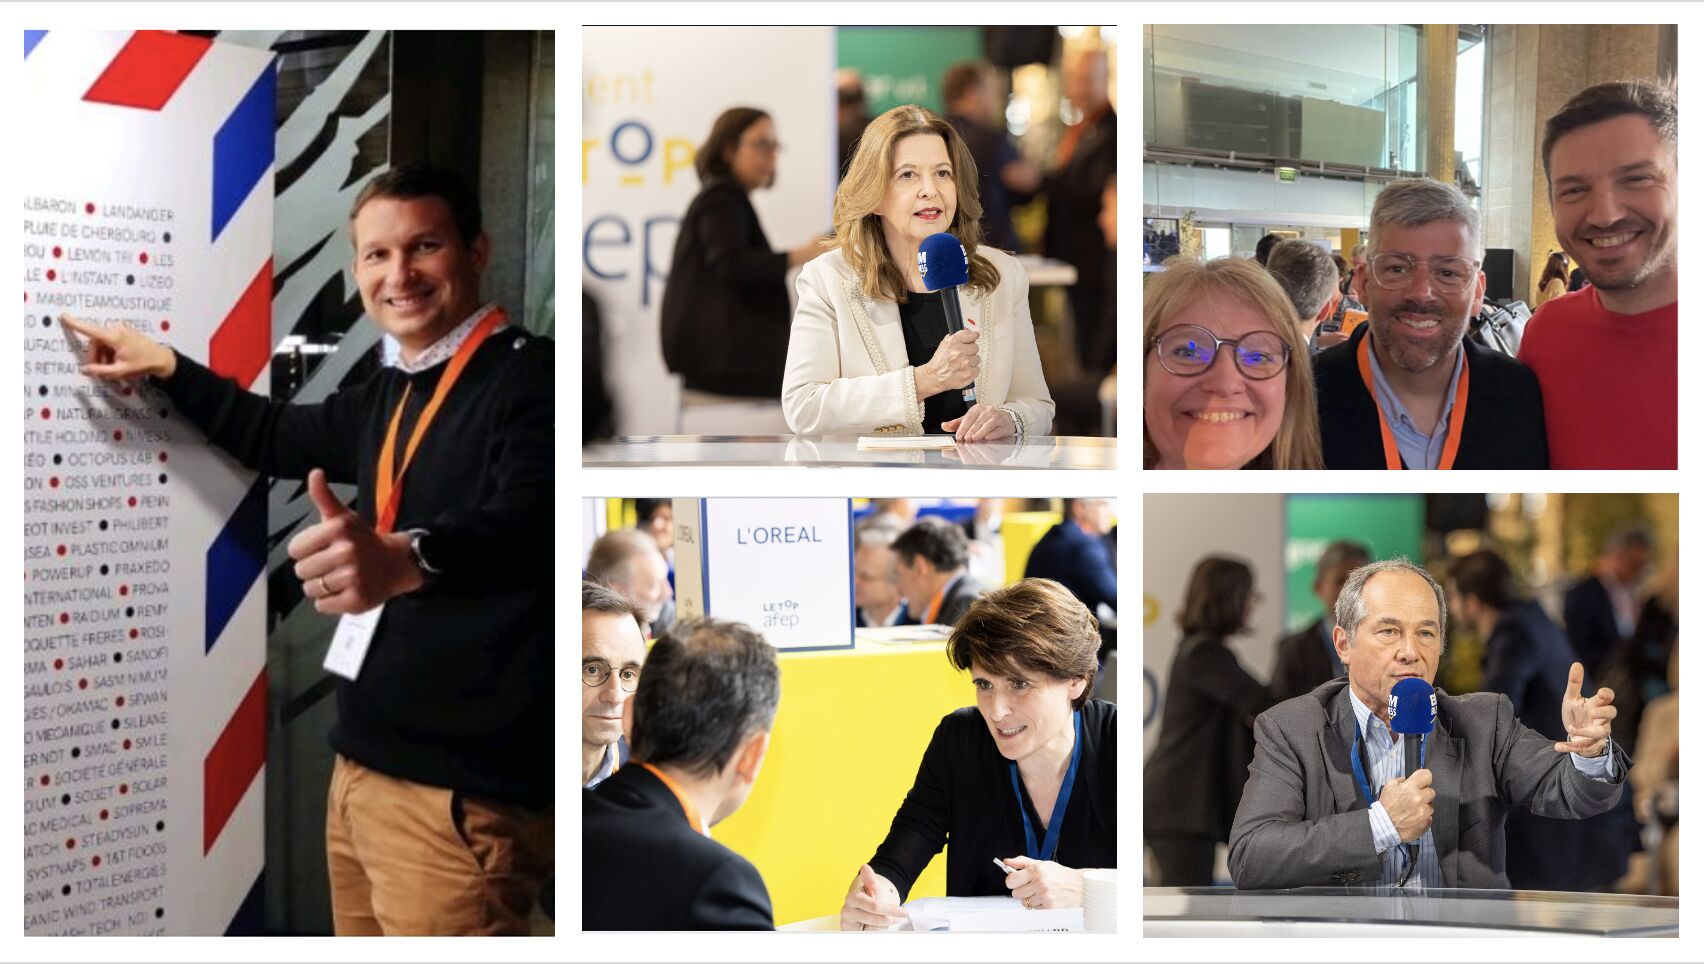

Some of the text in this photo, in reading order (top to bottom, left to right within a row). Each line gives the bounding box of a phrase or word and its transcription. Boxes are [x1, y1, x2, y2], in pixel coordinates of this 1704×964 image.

[103, 204, 174, 222] LANDANGER
[24, 220, 156, 244] PLUIE DE CHERBOURG
[68, 246, 111, 263] LEMON
[153, 253, 174, 267] LES
[57, 407, 109, 421] NATURAL
[55, 429, 107, 444] HOLDING
[68, 452, 129, 467] OCTOPUS
[131, 451, 152, 465] LAB
[64, 474, 88, 488] OSS
[91, 472, 152, 488] VENTURES
[33, 498, 83, 513] FASHION
[85, 496, 122, 511] SHOPS
[50, 518, 93, 536] INVEST
[113, 516, 169, 531] PHILIBERT
[737, 526, 822, 545] L'OREAL
[71, 540, 118, 556] PLASTIC
[120, 538, 169, 554] OMNIUM
[32, 564, 94, 582] POWERUP
[763, 599, 800, 612] LE TOP
[763, 612, 800, 631] afep
[68, 652, 108, 671] SAHAR
[126, 645, 169, 664] SANOFI
[84, 740, 118, 758] SMAC
[81, 823, 150, 849] STEADYSUN
[76, 862, 168, 895] TOTALENERGIES
